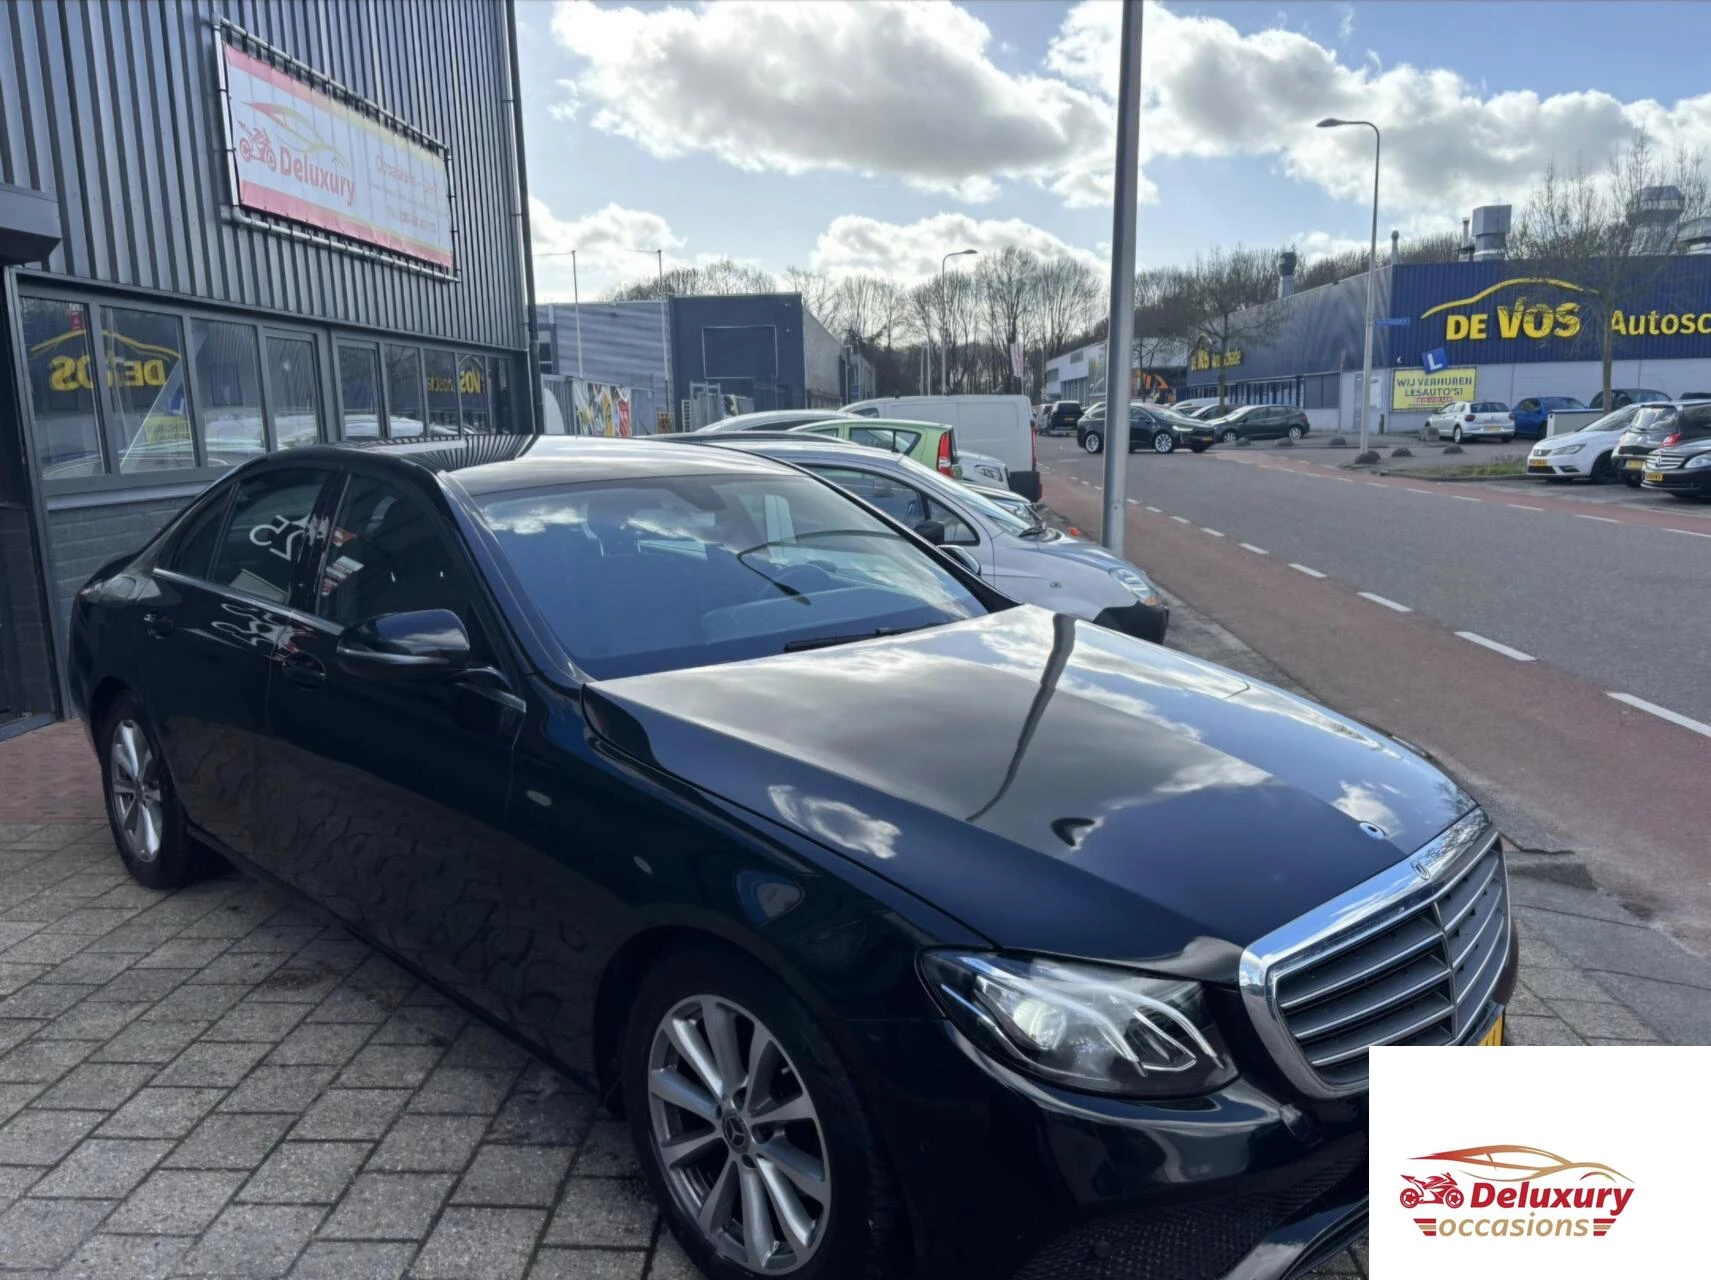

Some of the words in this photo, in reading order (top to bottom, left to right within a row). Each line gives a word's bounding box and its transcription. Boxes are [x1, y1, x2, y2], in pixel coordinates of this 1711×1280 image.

[280, 145, 355, 207] Deluxury
[1446, 314, 1488, 340] DE
[1497, 297, 1580, 338] VOS
[1427, 353, 1443, 371] L
[1397, 378, 1415, 387] WIJ
[1418, 377, 1472, 386] VERHUREN
